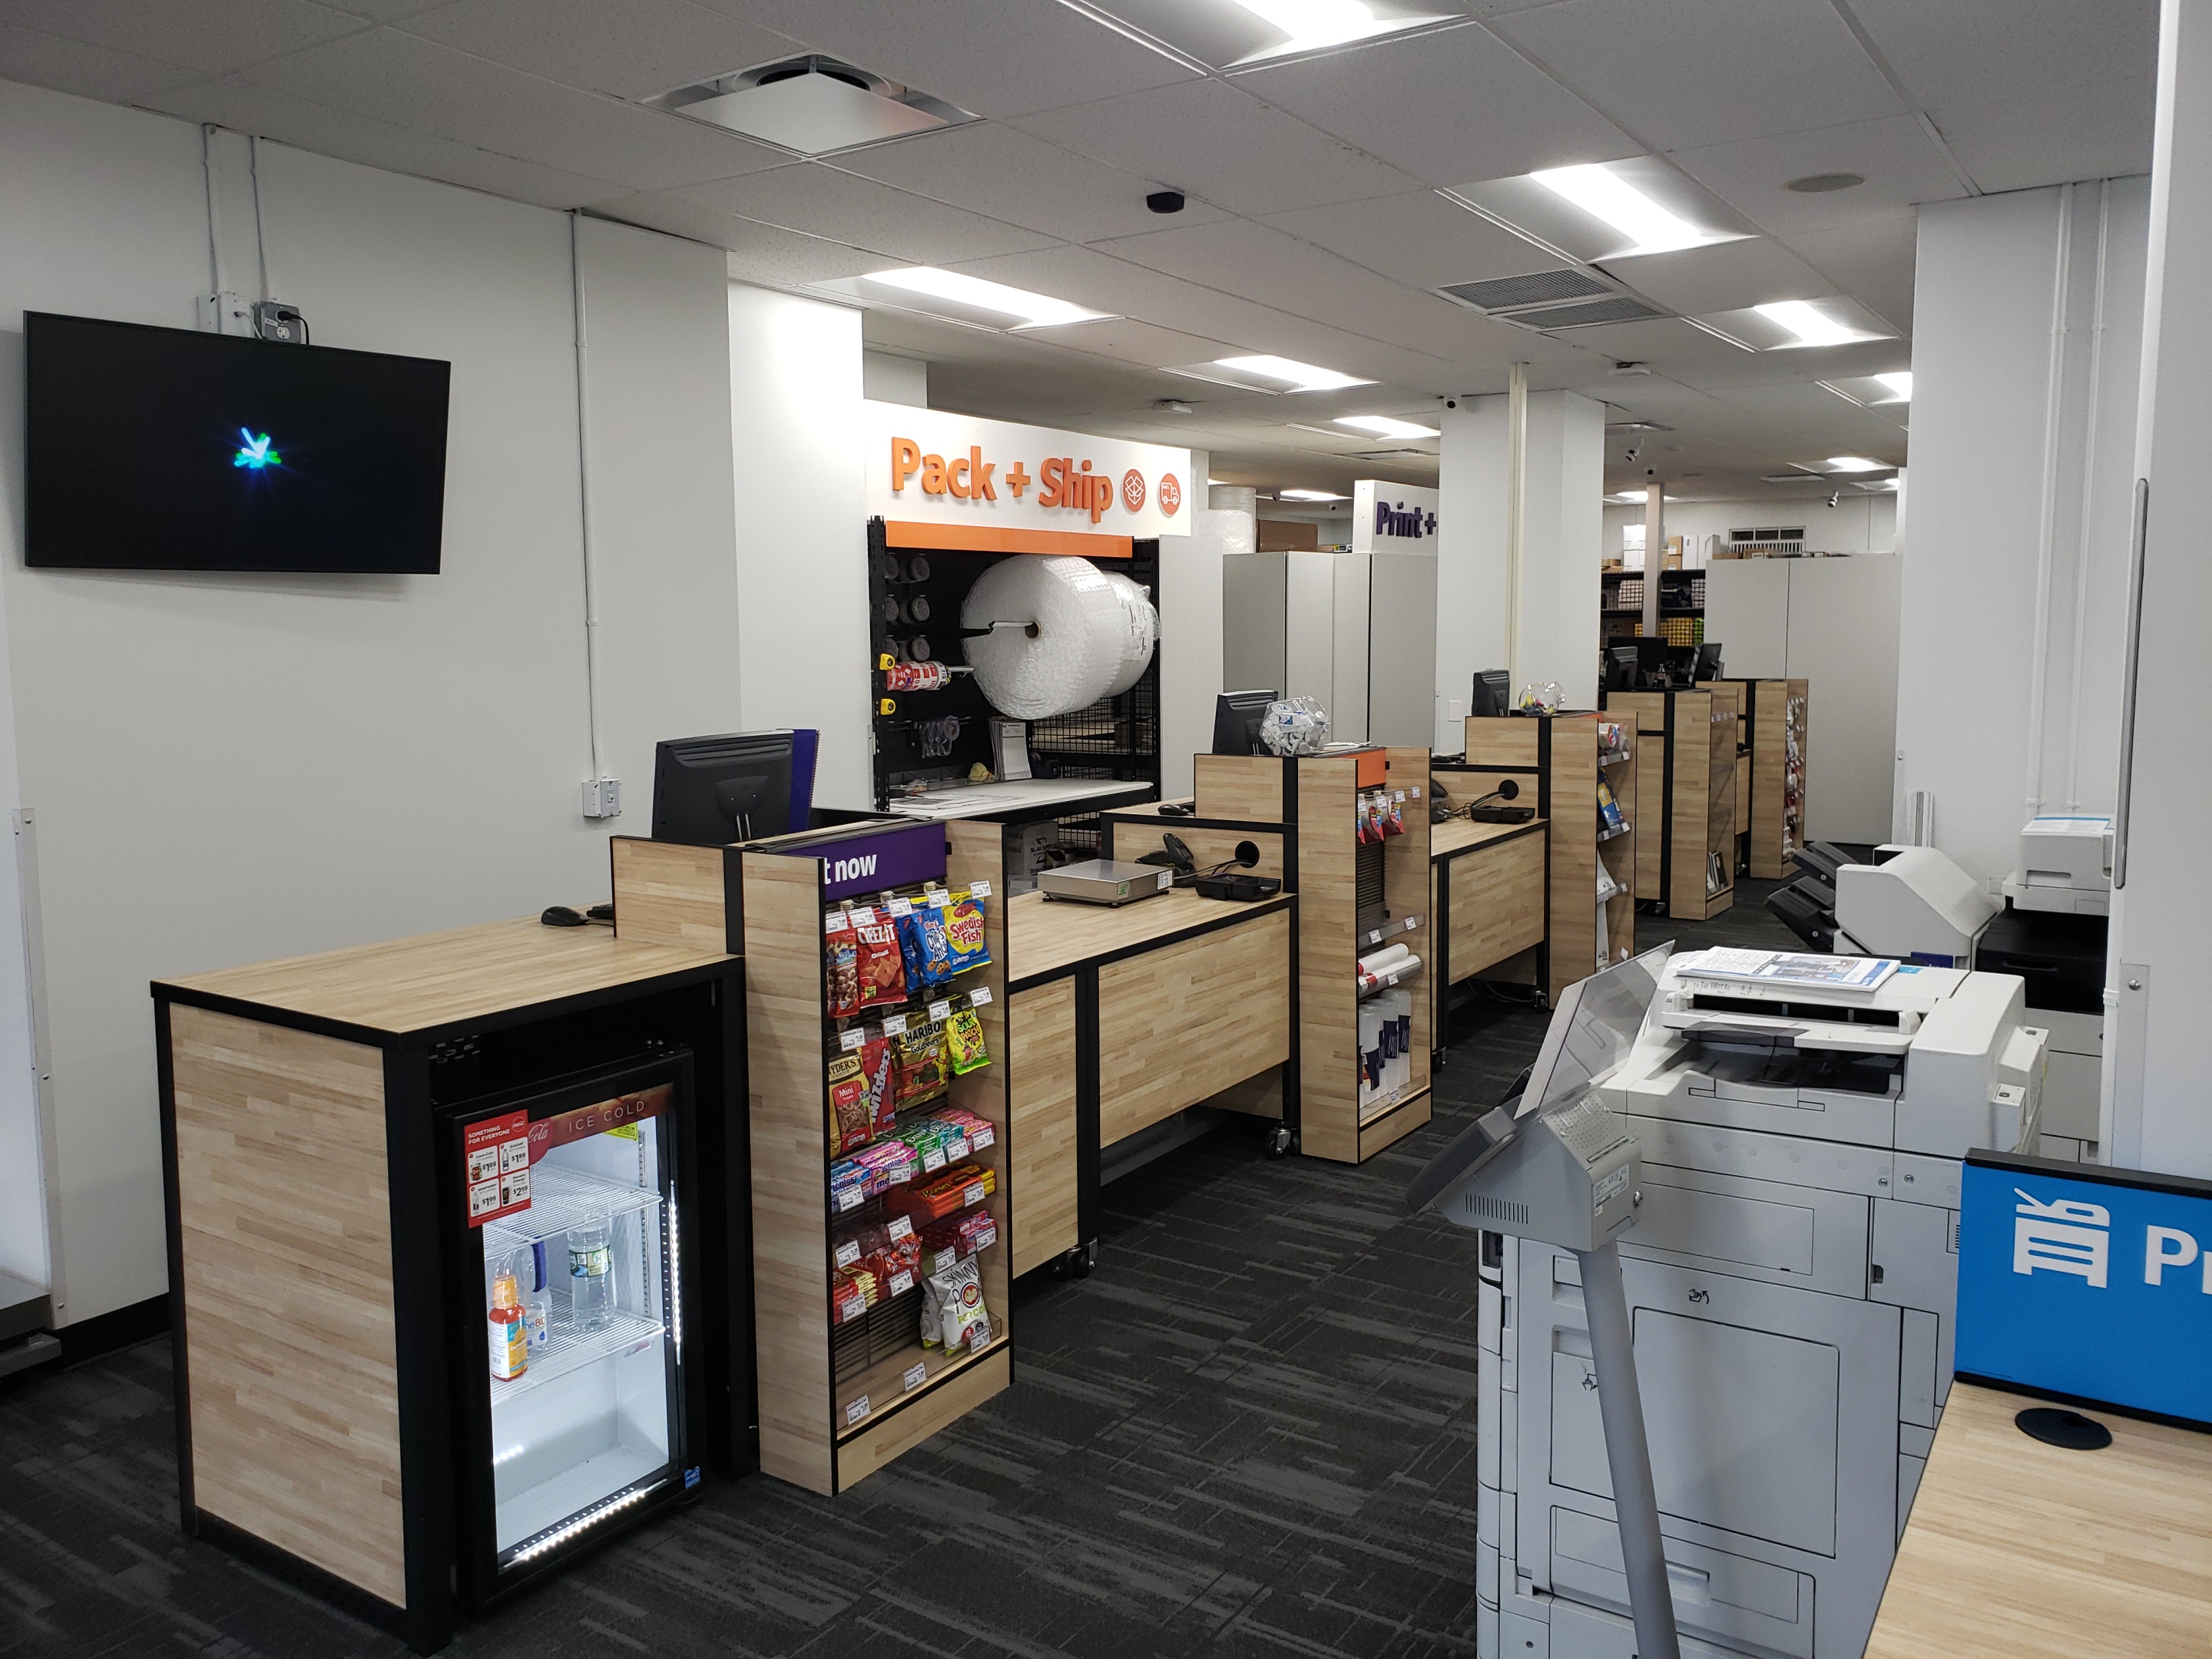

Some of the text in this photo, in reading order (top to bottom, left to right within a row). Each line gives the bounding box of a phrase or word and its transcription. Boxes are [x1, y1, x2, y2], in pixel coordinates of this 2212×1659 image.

[891, 436, 1114, 524] Pack + Ship
[1376, 501, 1437, 538] Print +
[835, 853, 877, 881] now
[961, 930, 982, 946] Fish
[904, 1021, 942, 1045] HARIBO
[956, 1018, 975, 1032] SOUR
[960, 1025, 980, 1041] PATCH
[911, 1037, 940, 1055] Goldbears
[830, 1058, 857, 1075] YDER'S
[839, 1086, 854, 1098] Mini
[569, 1115, 594, 1134] ICE
[604, 1100, 646, 1121] COLD
[468, 1125, 501, 1139] SOMETHING
[482, 1128, 511, 1141] EVERYONE
[957, 1304, 986, 1324] POPCO
